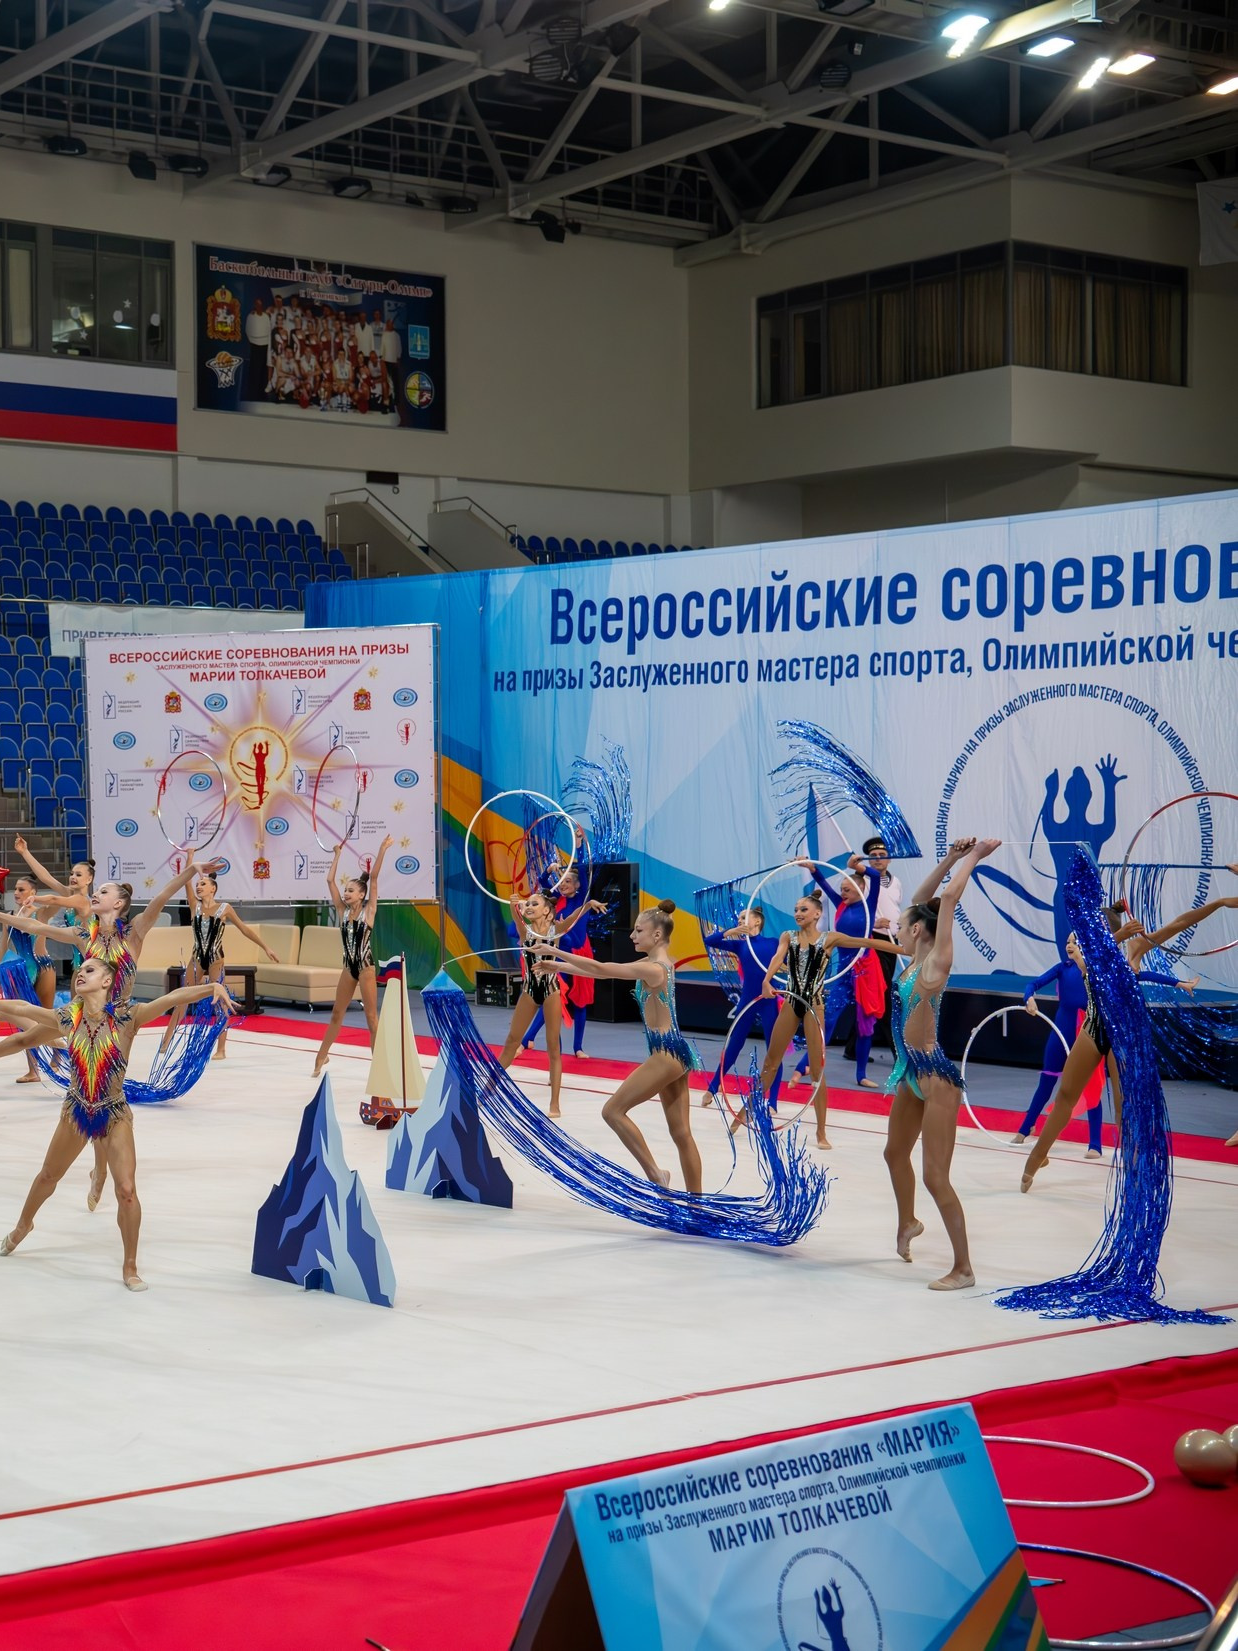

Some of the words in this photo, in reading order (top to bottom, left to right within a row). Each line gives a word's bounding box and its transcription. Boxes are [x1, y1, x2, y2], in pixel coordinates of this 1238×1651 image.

[550, 570, 917, 655] Всероссийские
[109, 648, 223, 664] ВСЕРОССИЙСКИЕ
[226, 646, 335, 660] СОРЕВНОВАНИЯ
[339, 645, 357, 656] НА
[361, 643, 409, 655] ПРИЗЫ
[189, 671, 237, 682] МАРИИ
[239, 666, 326, 681] ТОЛКАЧЕВОЙ
[268, 659, 319, 667] ОЛИМПИЙСКОЙ
[320, 658, 361, 666] ЧЕМПИОНКИ
[493, 668, 516, 692] на
[522, 666, 584, 697] призы
[589, 659, 748, 693] Заслуженного
[757, 653, 859, 687] мастера
[869, 647, 973, 682] спорта,
[982, 625, 1194, 671] Олимпийской
[1002, 683, 1077, 718] ЗАСЛУЖЕННОГО
[1078, 683, 1123, 706] МАСТЕРА
[1123, 695, 1159, 729] СПОРТА,
[974, 709, 1005, 743] ПРИЗЫ
[965, 738, 980, 756] НА
[1156, 720, 1209, 794] ОЛИМПИЙСКОЙ
[942, 753, 969, 800] «МАРИЯ»
[1196, 797, 1214, 870] ЧЕМПИОНКИ
[953, 901, 997, 963] ВСЕРОССИЙС
[727, 992, 741, 1019] 2
[594, 1471, 741, 1521] Всероссийские
[745, 1442, 874, 1490] соревнования
[876, 1420, 960, 1457] «МАРИЯ»
[607, 1528, 624, 1544] на
[626, 1519, 664, 1542] призы
[664, 1500, 747, 1531] Заслуженного
[749, 1489, 797, 1512] мастера
[798, 1480, 839, 1502] спорта,
[838, 1462, 910, 1491] Олимпийской
[910, 1451, 967, 1475] чемпионки
[708, 1516, 776, 1553] МАРИИ
[777, 1484, 893, 1536] ТОЛКАЧЕВОЙ
